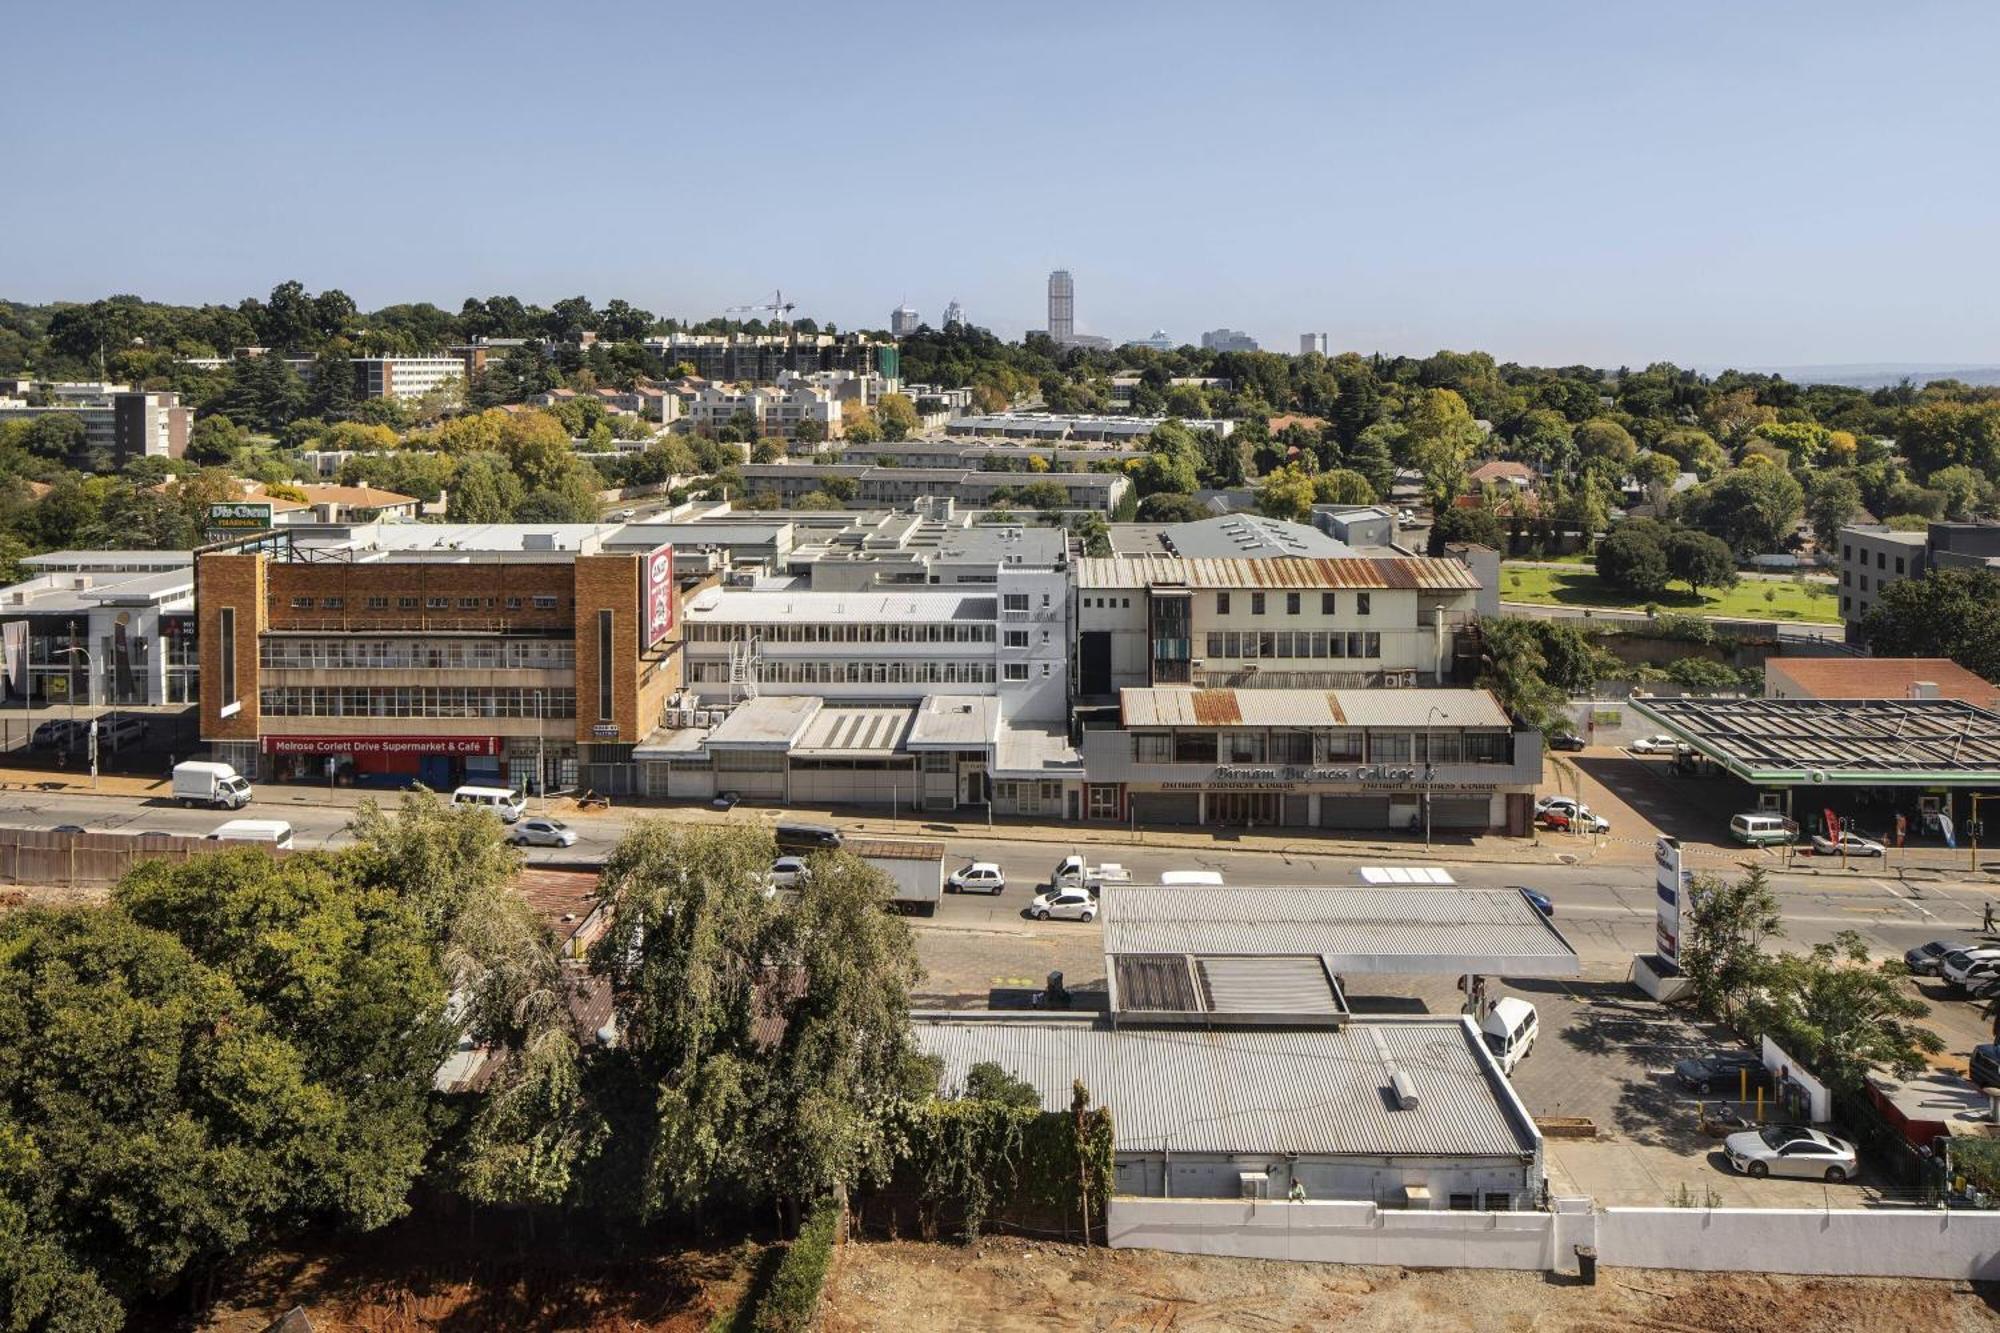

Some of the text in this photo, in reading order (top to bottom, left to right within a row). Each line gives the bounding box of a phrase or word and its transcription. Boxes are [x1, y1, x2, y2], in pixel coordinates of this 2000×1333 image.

[276, 742, 480, 752] Melrose Corlett Drive Supermarket & Café
[1356, 765, 1416, 784] College
